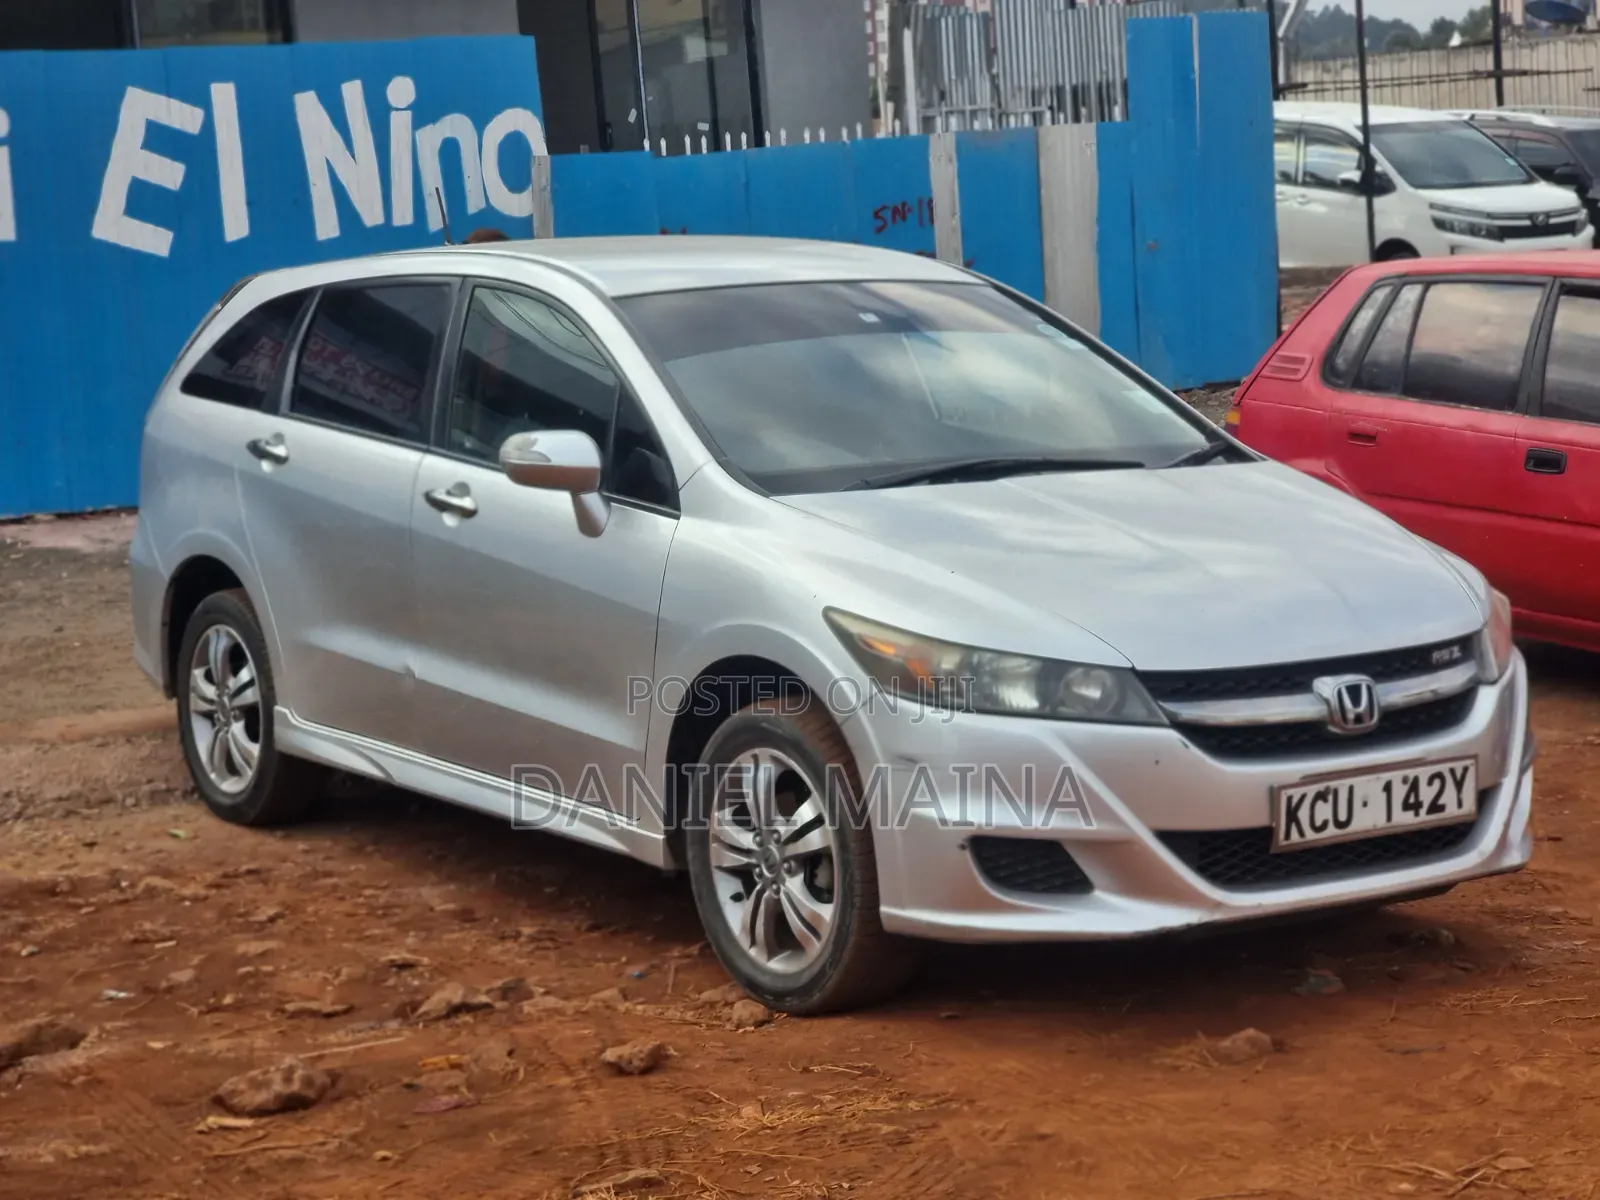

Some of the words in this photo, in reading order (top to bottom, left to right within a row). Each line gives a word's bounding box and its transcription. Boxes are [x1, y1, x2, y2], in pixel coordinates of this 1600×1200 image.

[91, 82, 250, 258] El
[294, 75, 548, 242] Nino
[1283, 784, 1354, 841] KCU
[1382, 765, 1469, 823] 142Y
